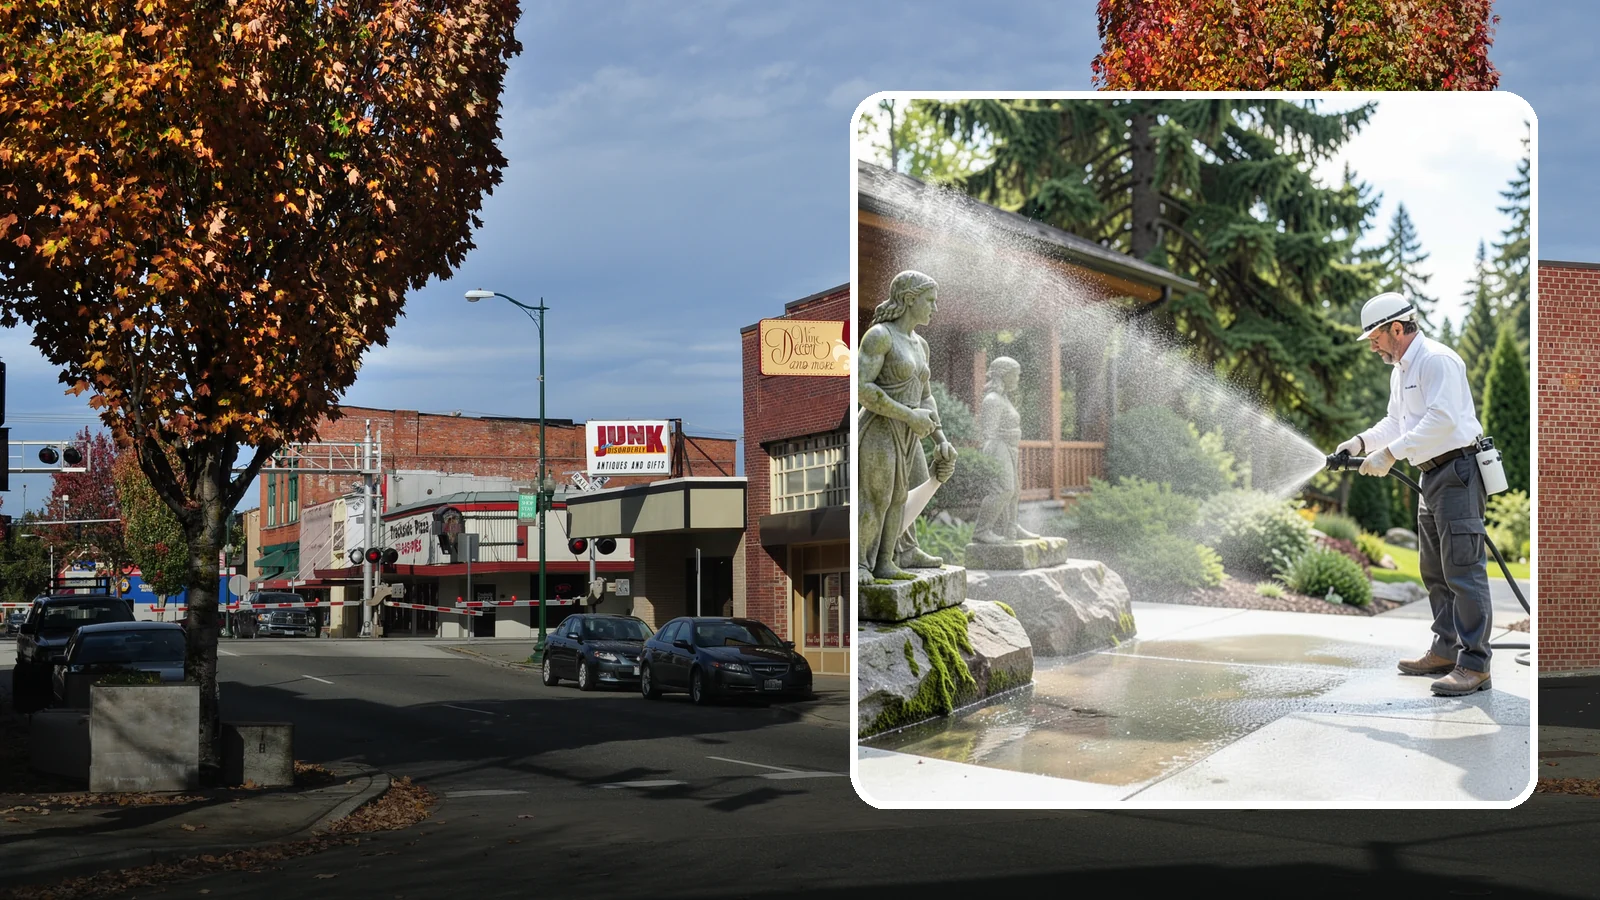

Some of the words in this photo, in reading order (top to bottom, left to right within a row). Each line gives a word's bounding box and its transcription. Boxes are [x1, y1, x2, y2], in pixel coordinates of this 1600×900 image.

[791, 325, 824, 344] Wine
[596, 425, 665, 457] JUNK
[607, 446, 646, 454] DISORDERLY
[597, 461, 628, 470] ANTIQUES
[631, 461, 644, 470] AND
[647, 460, 666, 469] GIFTS
[390, 521, 413, 539] Trackside
[414, 520, 429, 535] Pizza
